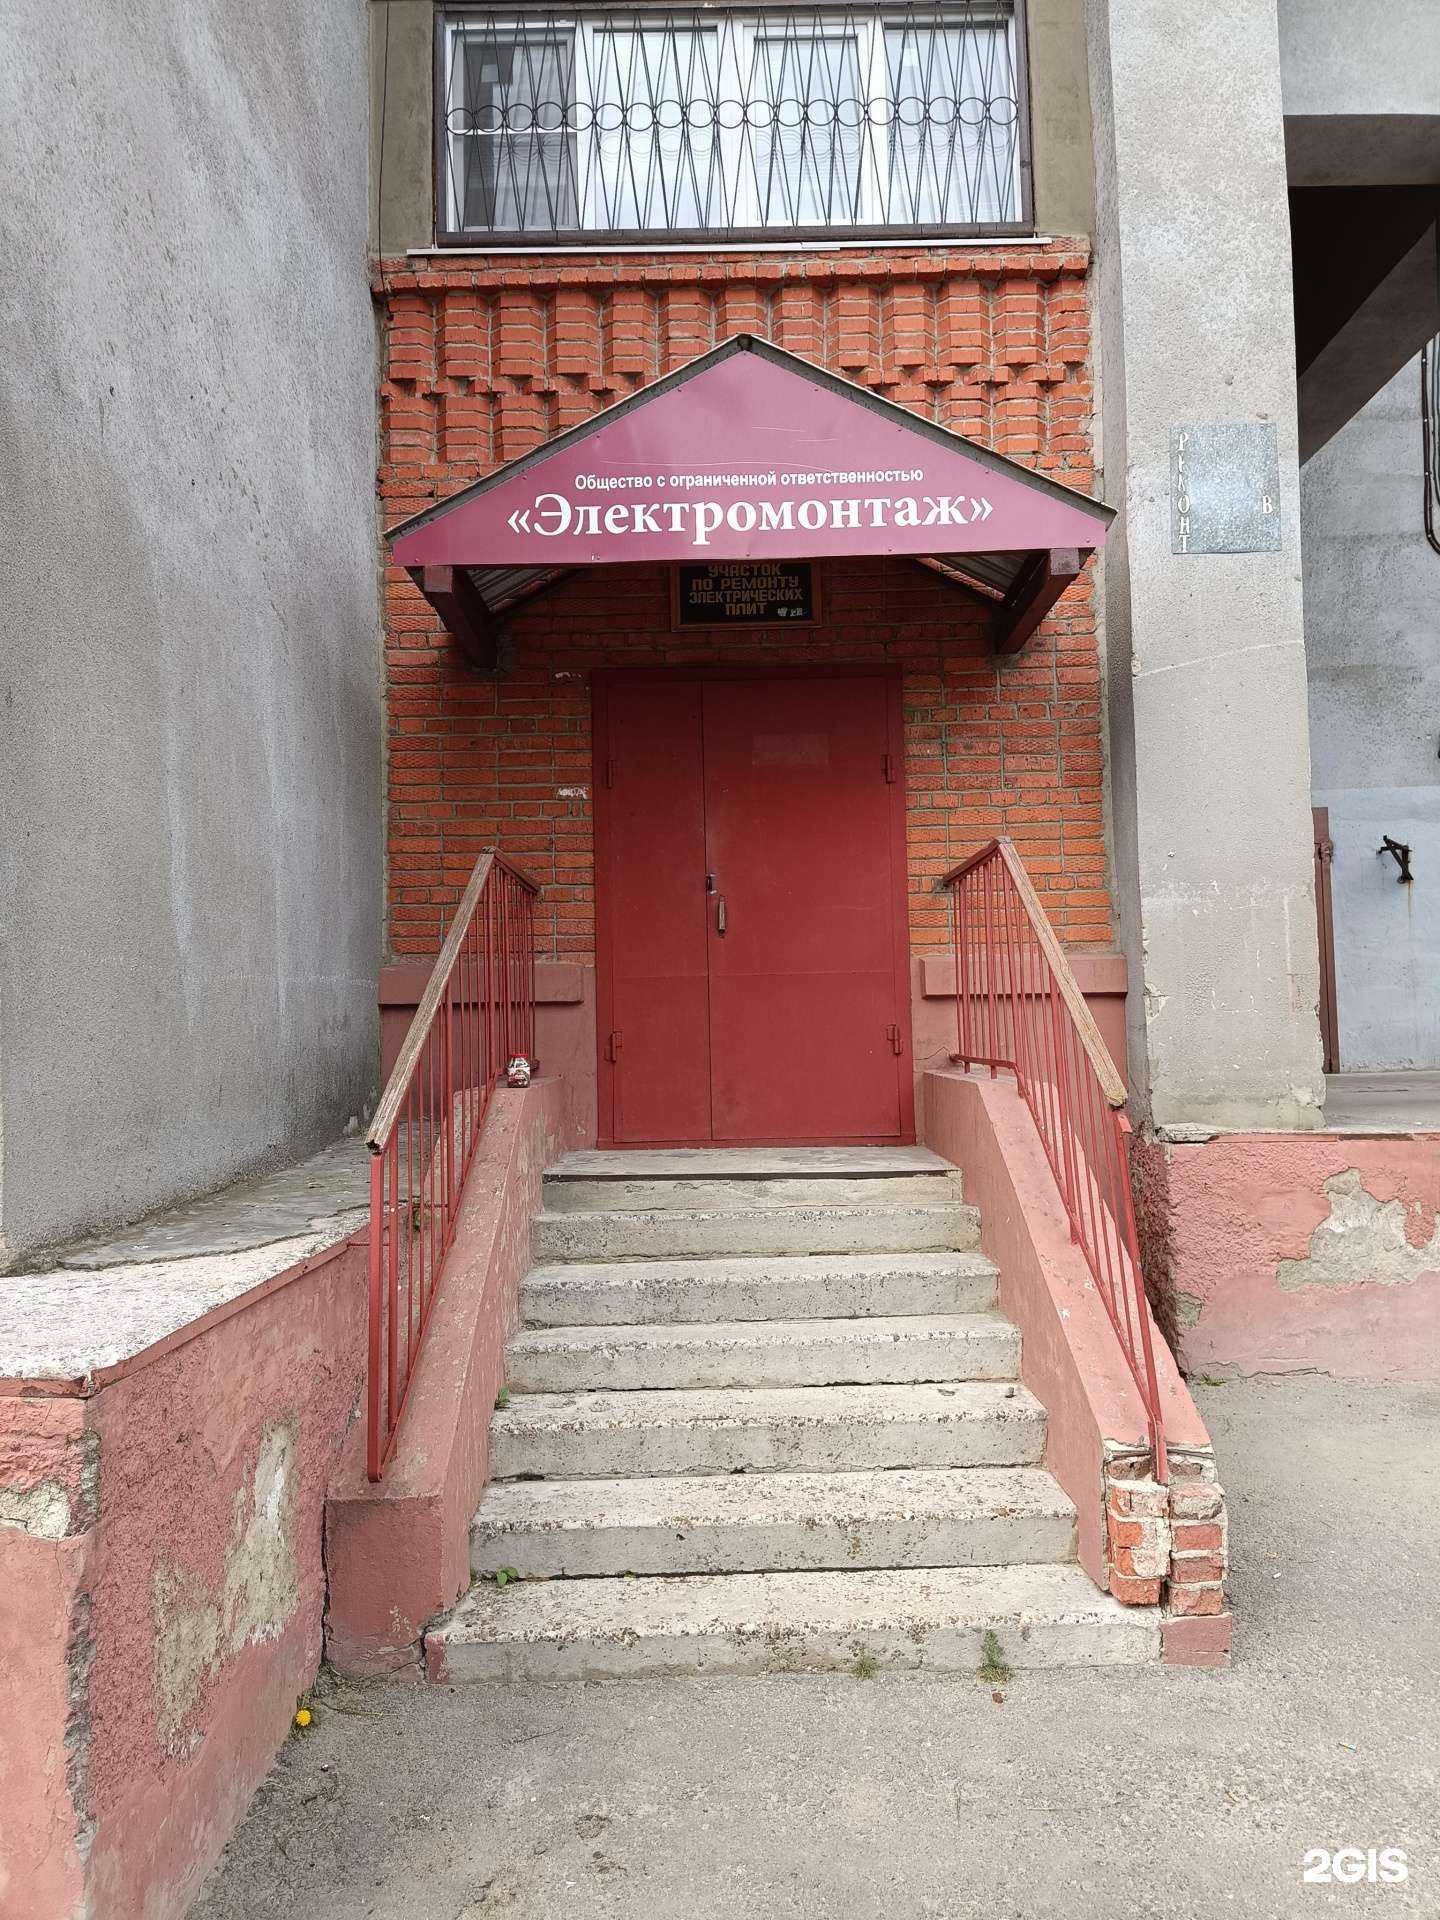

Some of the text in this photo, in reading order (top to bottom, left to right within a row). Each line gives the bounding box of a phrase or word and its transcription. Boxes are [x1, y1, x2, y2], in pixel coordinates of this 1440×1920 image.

[575, 469, 924, 491] Общество с ограниченной ответственностью
[507, 493, 994, 546] «Электромонтаж»
[708, 563, 782, 577] УЧАСТОК
[691, 575, 799, 591] ПО РЕМОНТУ
[688, 588, 803, 603] ЭЛЕКТРИЧЕСКИХ
[725, 602, 768, 615] ПЛИТ
